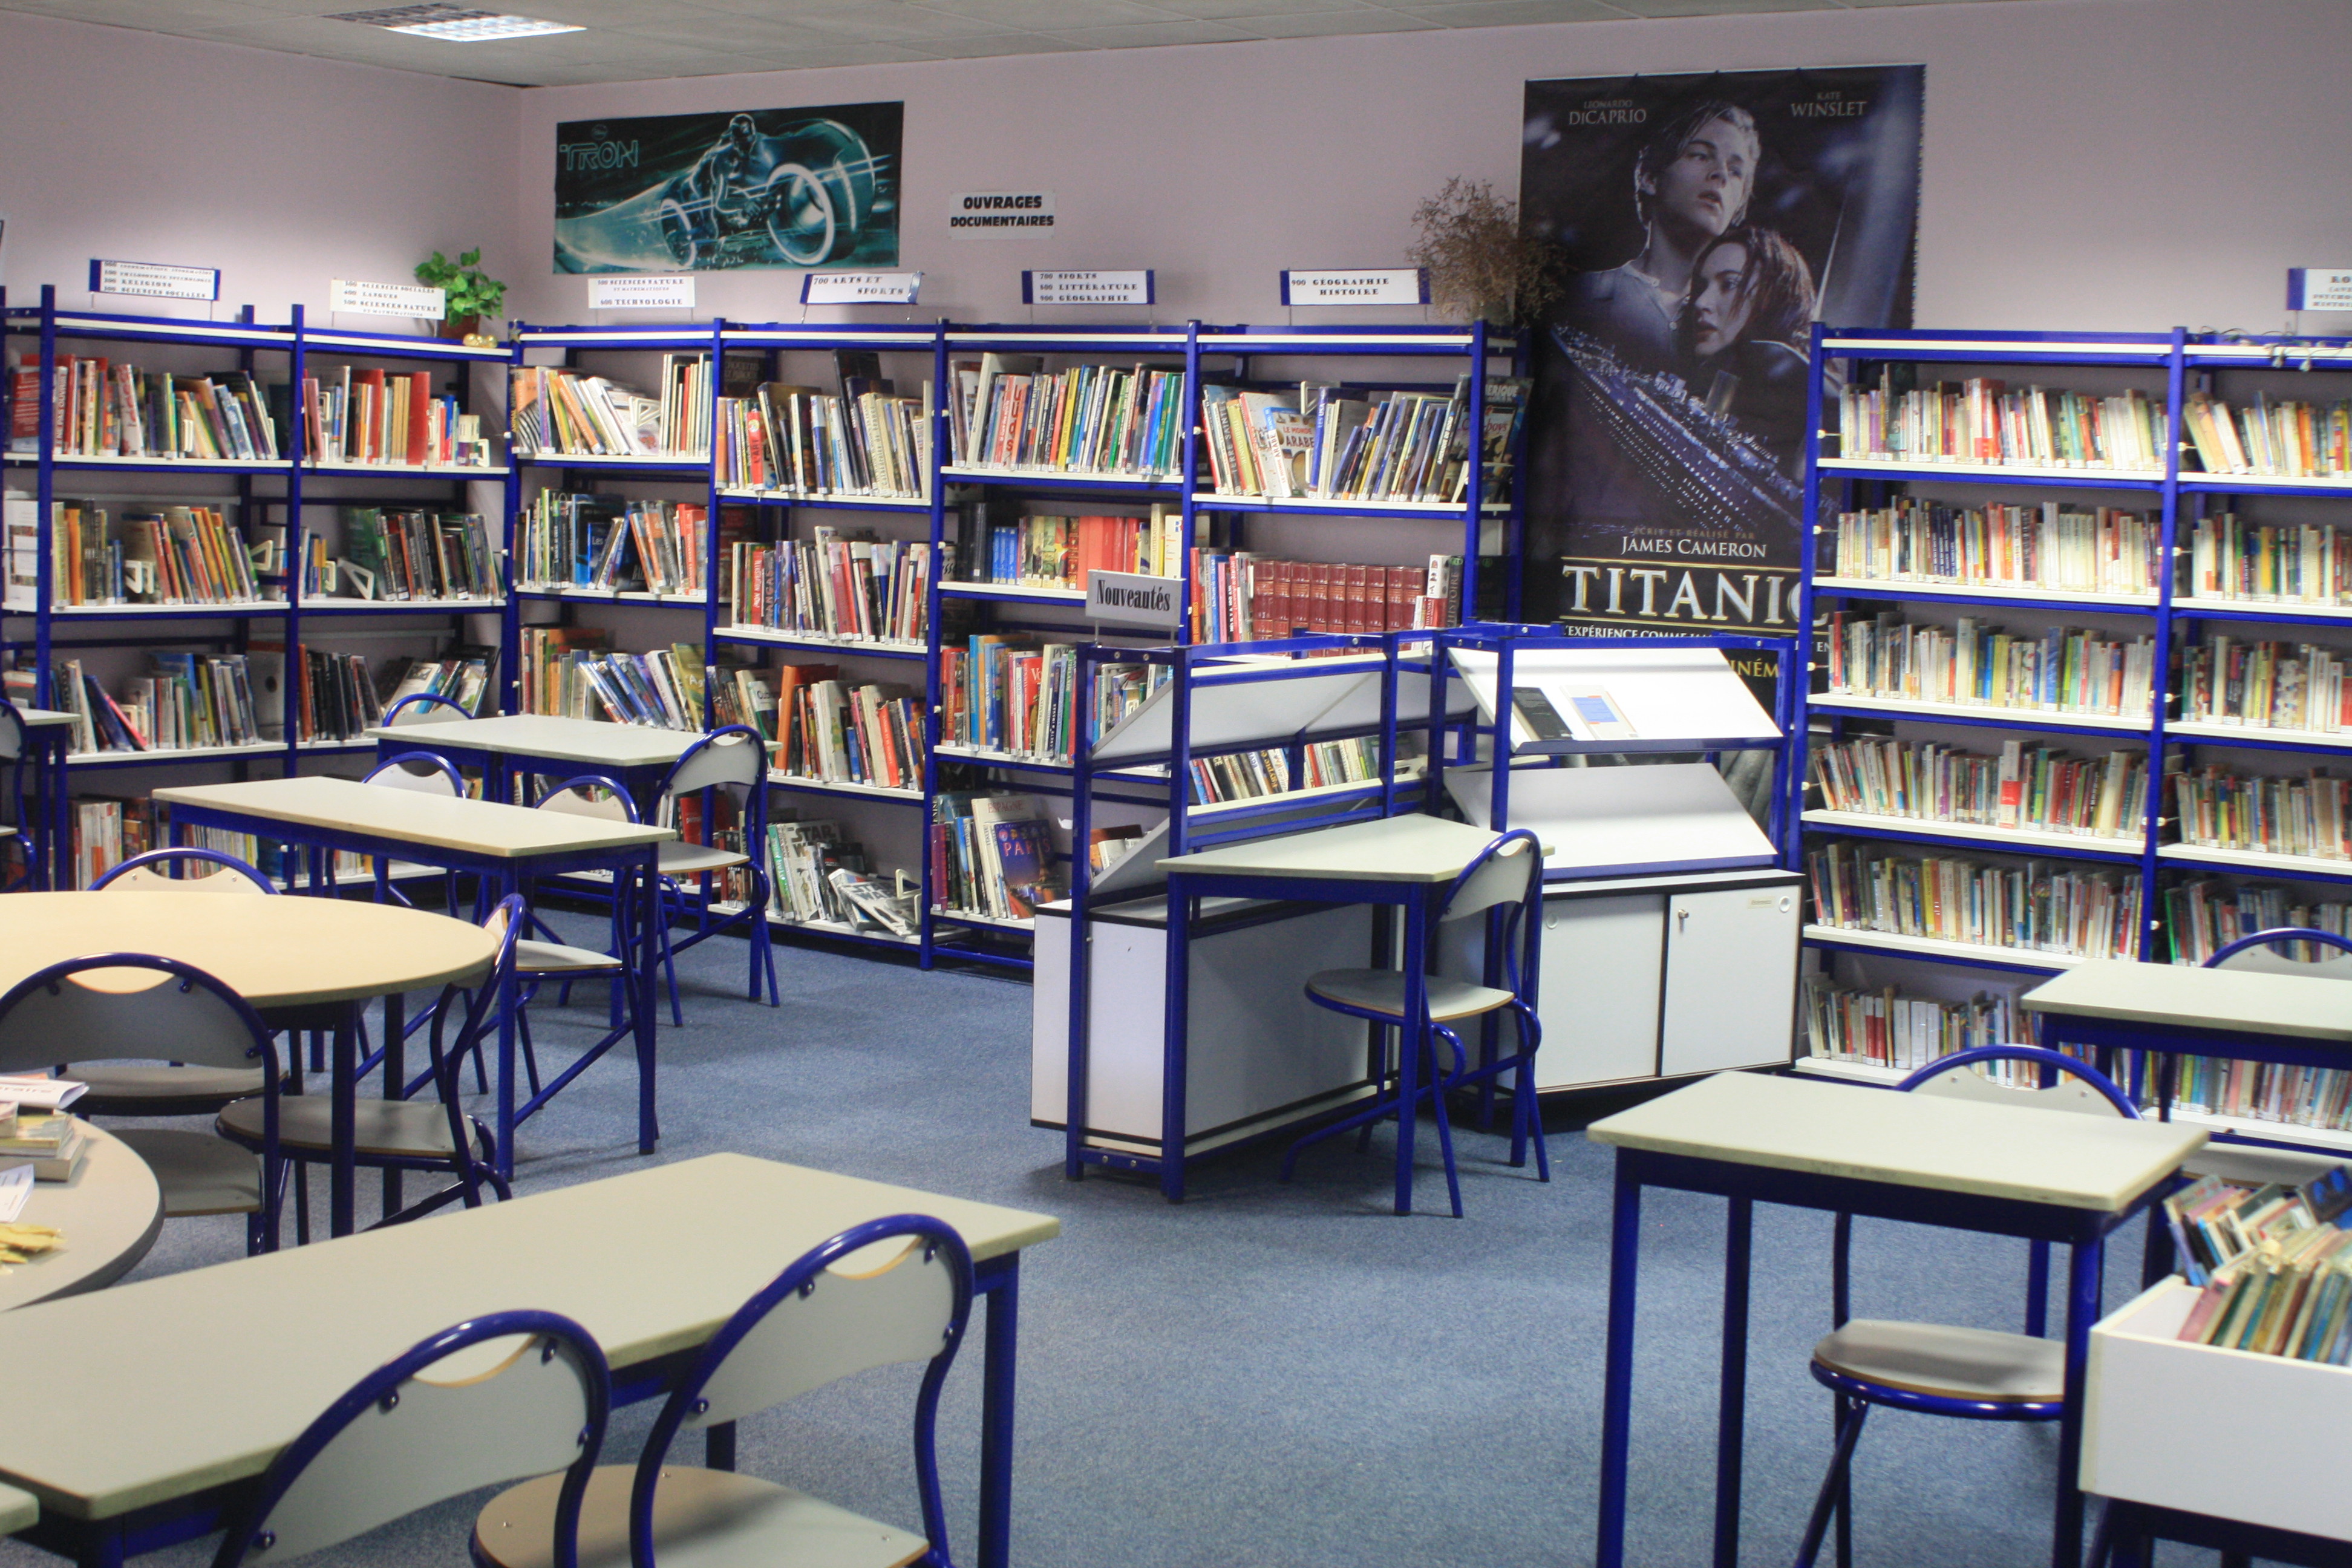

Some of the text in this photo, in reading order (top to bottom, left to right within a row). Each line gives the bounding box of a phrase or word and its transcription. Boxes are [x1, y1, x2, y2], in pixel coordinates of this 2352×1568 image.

[1816, 91, 1841, 100] KATE
[1583, 99, 1633, 109] LEONARDO
[1791, 101, 1868, 119] WINSLET
[559, 139, 639, 171] TRON
[963, 195, 1042, 209] OUVRAGES
[950, 215, 1054, 227] DOCUMENTAIRES
[121, 279, 172, 287] RELIGIONS
[1313, 277, 1390, 286] GÉOGRAPHIE
[360, 300, 401, 309] SCIENCES
[1220, 406, 1238, 473] TERRE SAINTE
[1270, 434, 1281, 458] ARABE
[1285, 436, 1315, 448] ARABE
[1669, 529, 1681, 538] ET
[1687, 528, 1729, 539] RÉALISÉ
[1734, 531, 1754, 540] PAR
[1621, 536, 1767, 558] JAMES CAMERON
[1096, 579, 1171, 612] Nouveautés
[1562, 564, 1829, 627] TITANIC
[1564, 625, 1638, 638] 'EXPÉRIENCE
[987, 800, 1023, 814] ESPAGNE
[791, 826, 837, 843] STAR
